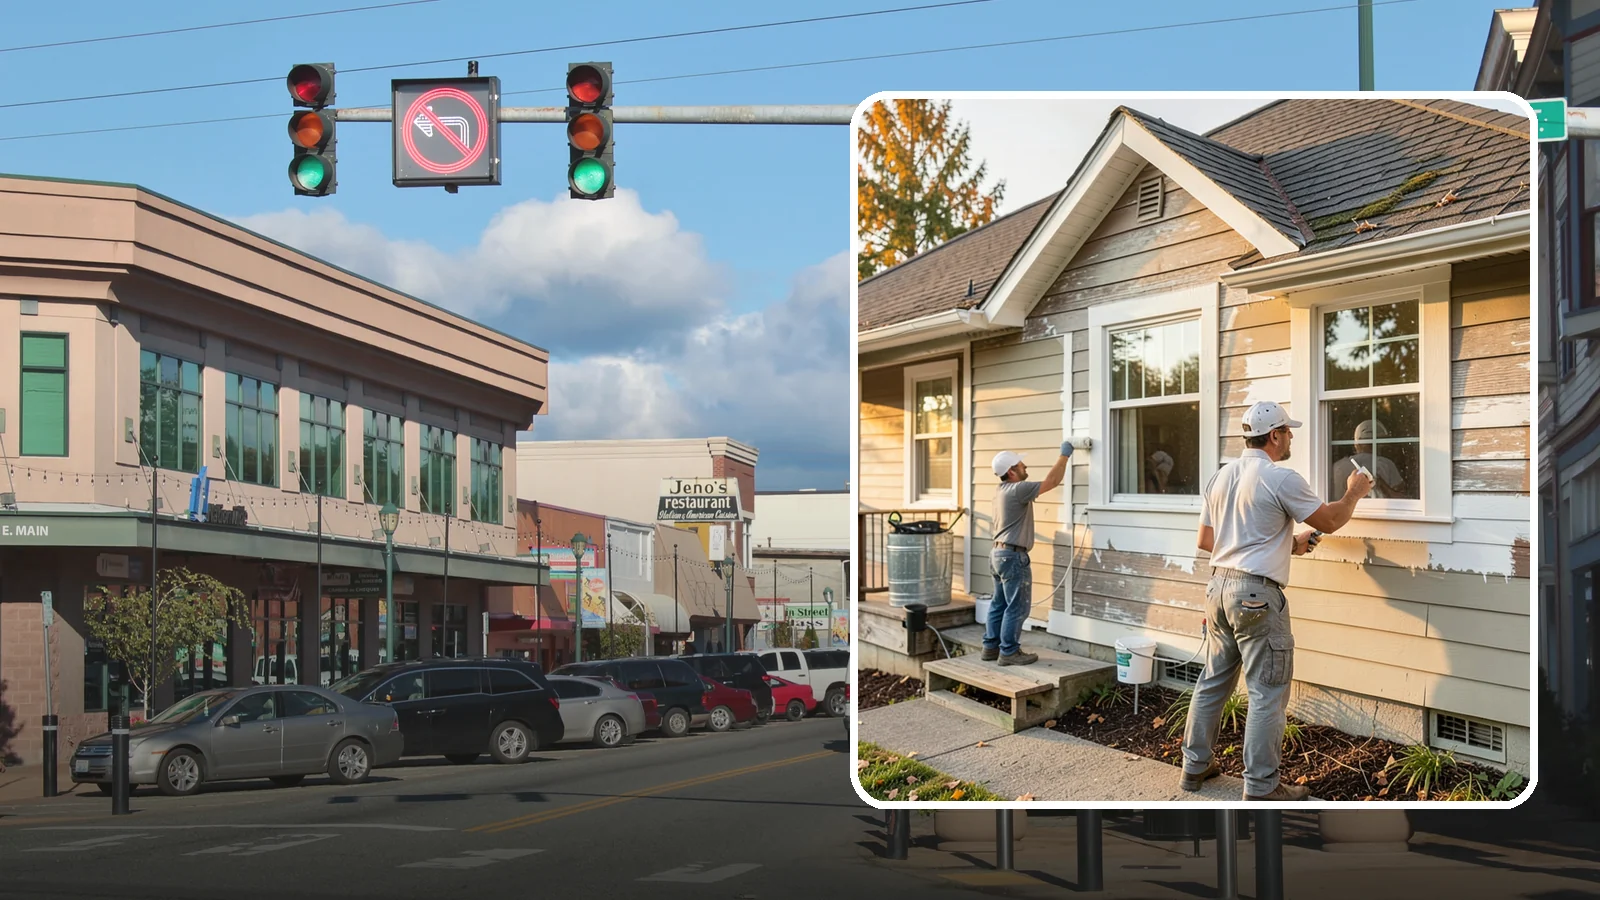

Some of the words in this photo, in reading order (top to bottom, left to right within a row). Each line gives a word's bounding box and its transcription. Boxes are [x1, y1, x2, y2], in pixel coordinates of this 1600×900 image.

[669, 479, 727, 494] Jeno's
[665, 496, 731, 509] restaurant
[686, 509, 714, 519] American
[714, 509, 738, 519] Cuisine
[2, 525, 13, 536] E.
[15, 525, 49, 536] MAIN
[786, 607, 795, 617] in
[797, 607, 828, 617] Street
